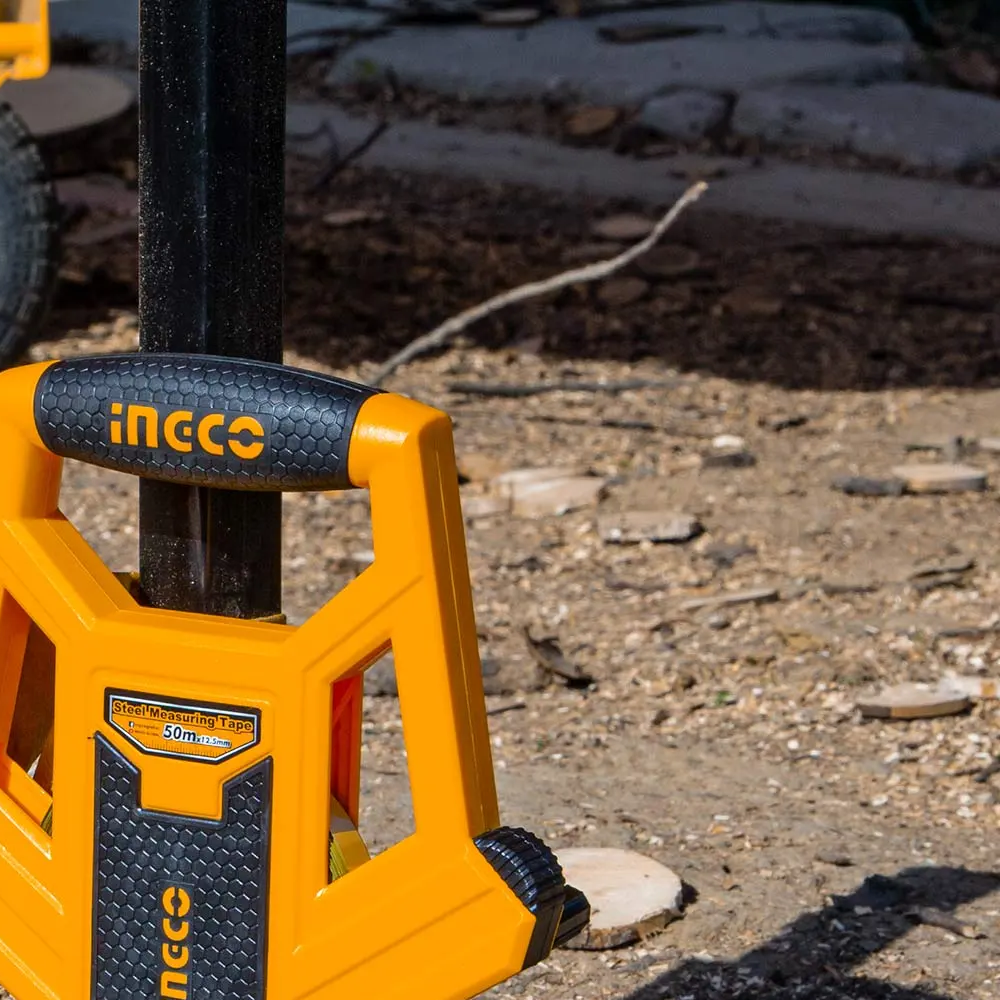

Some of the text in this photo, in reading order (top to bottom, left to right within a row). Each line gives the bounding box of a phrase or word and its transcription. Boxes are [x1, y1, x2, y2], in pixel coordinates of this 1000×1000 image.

[113, 702, 145, 716] Steel
[149, 709, 215, 728] Measuring
[219, 717, 252, 732] Tape
